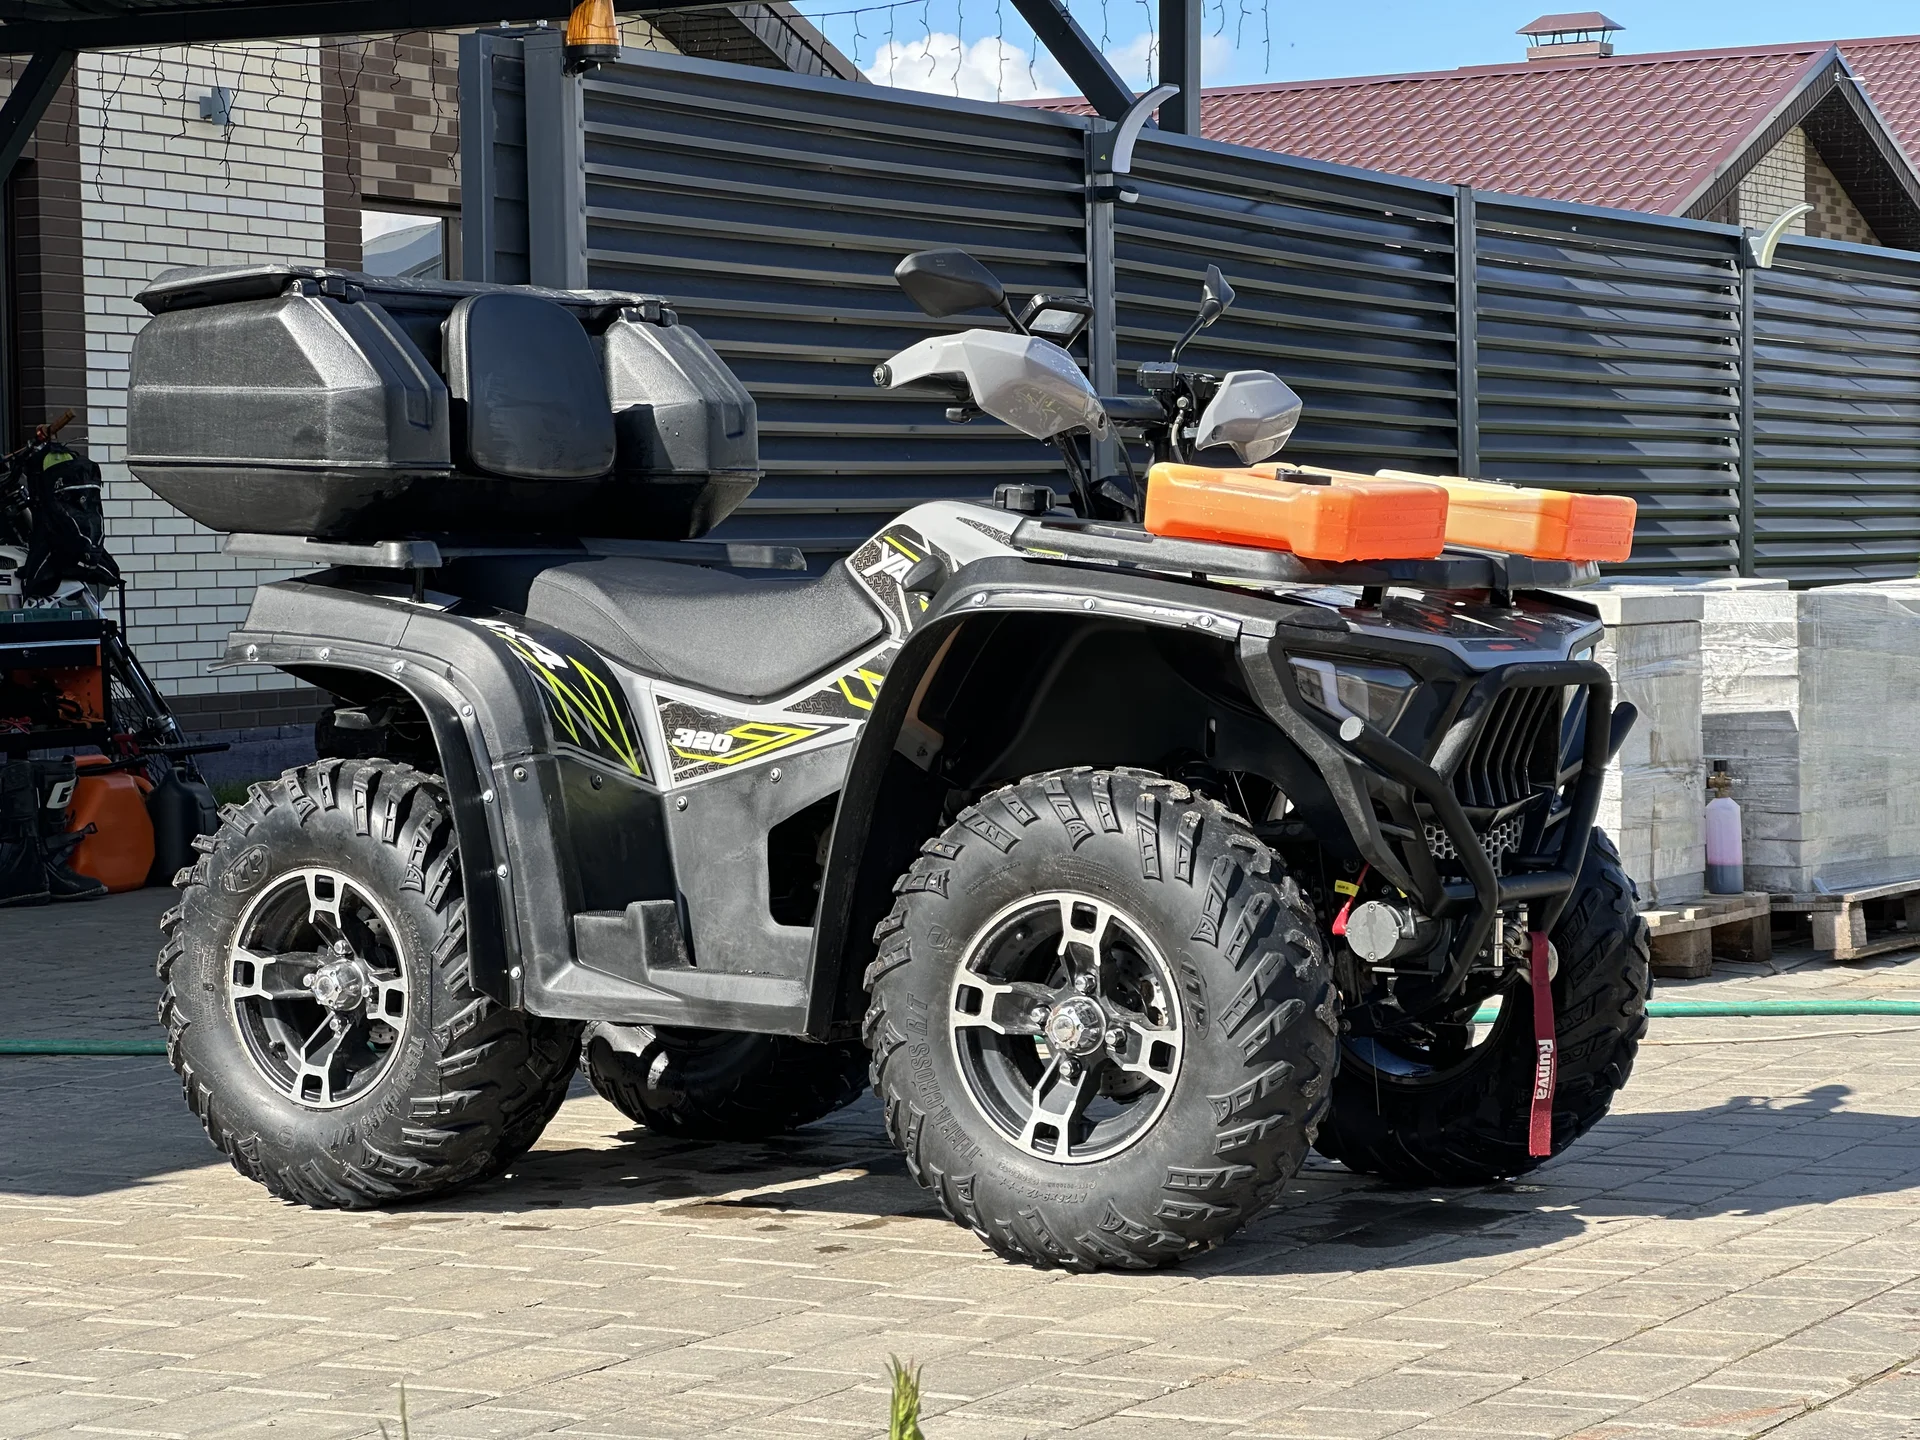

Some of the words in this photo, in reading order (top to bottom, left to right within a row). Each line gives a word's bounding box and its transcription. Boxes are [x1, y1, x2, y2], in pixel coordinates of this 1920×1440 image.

[671, 728, 734, 753] 320
[222, 848, 264, 892] ITP
[905, 993, 928, 1036] R/T
[1181, 960, 1208, 1032] ITP
[1535, 1039, 1554, 1100] Runva
